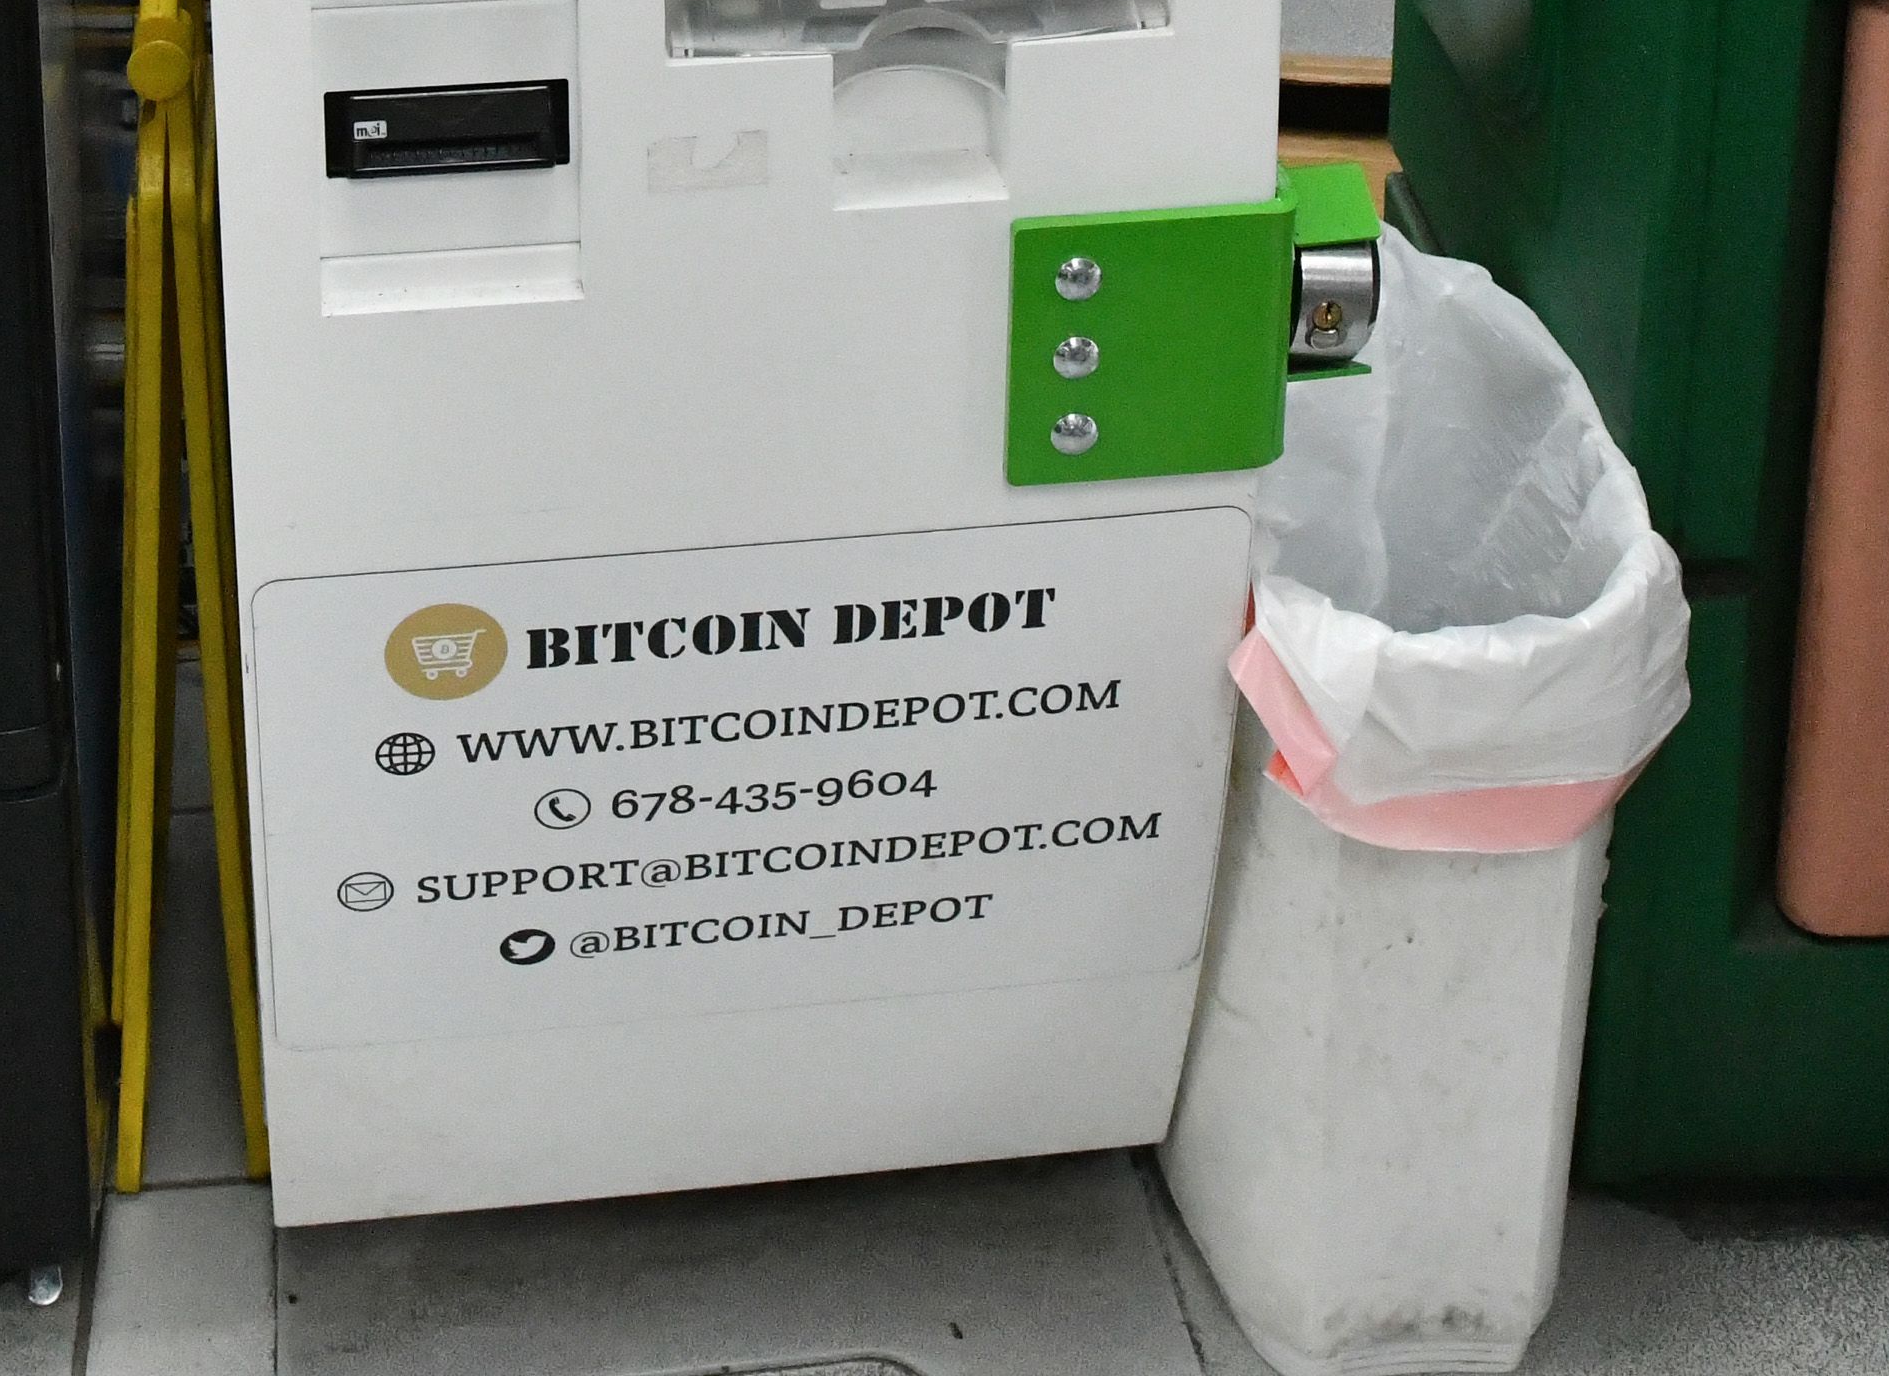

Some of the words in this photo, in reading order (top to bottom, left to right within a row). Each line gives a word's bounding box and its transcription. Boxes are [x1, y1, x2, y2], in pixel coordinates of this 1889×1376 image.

[526, 607, 811, 670] BITCOIN
[833, 587, 1058, 646] DEPOT
[457, 679, 1123, 765] WWW.BITCOINDEPOT.COM
[611, 767, 938, 822] 678-435-9604
[415, 812, 1164, 906] SUPPORT@BITCOINDEPOT.COM
[569, 893, 994, 959] @BITCOIN_DEPOT
